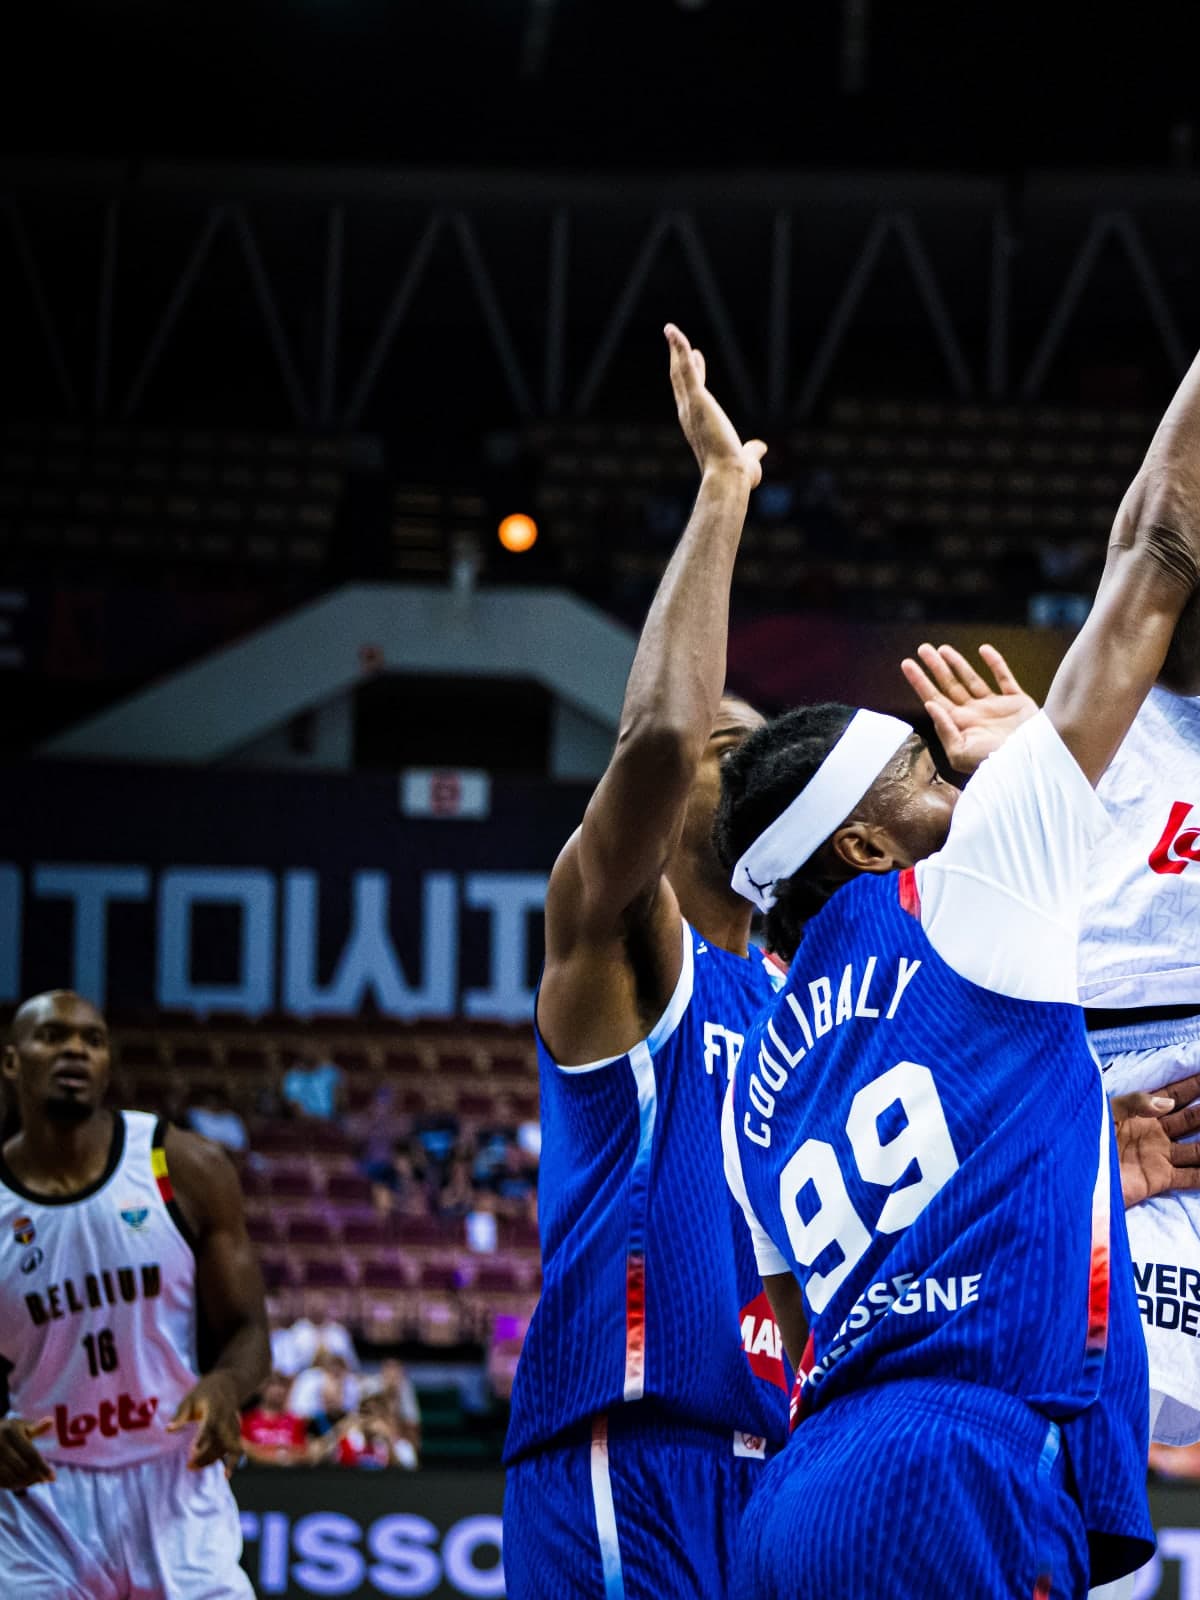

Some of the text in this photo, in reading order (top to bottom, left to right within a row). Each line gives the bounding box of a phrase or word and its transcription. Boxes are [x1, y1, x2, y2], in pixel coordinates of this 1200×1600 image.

[0, 862, 548, 1025] TOWI
[743, 956, 922, 1149] COULIBALY
[779, 1060, 960, 1316] 99
[24, 1263, 162, 1326] BELGIUM
[82, 1328, 119, 1377] 16
[240, 1511, 507, 1598] ISSO
